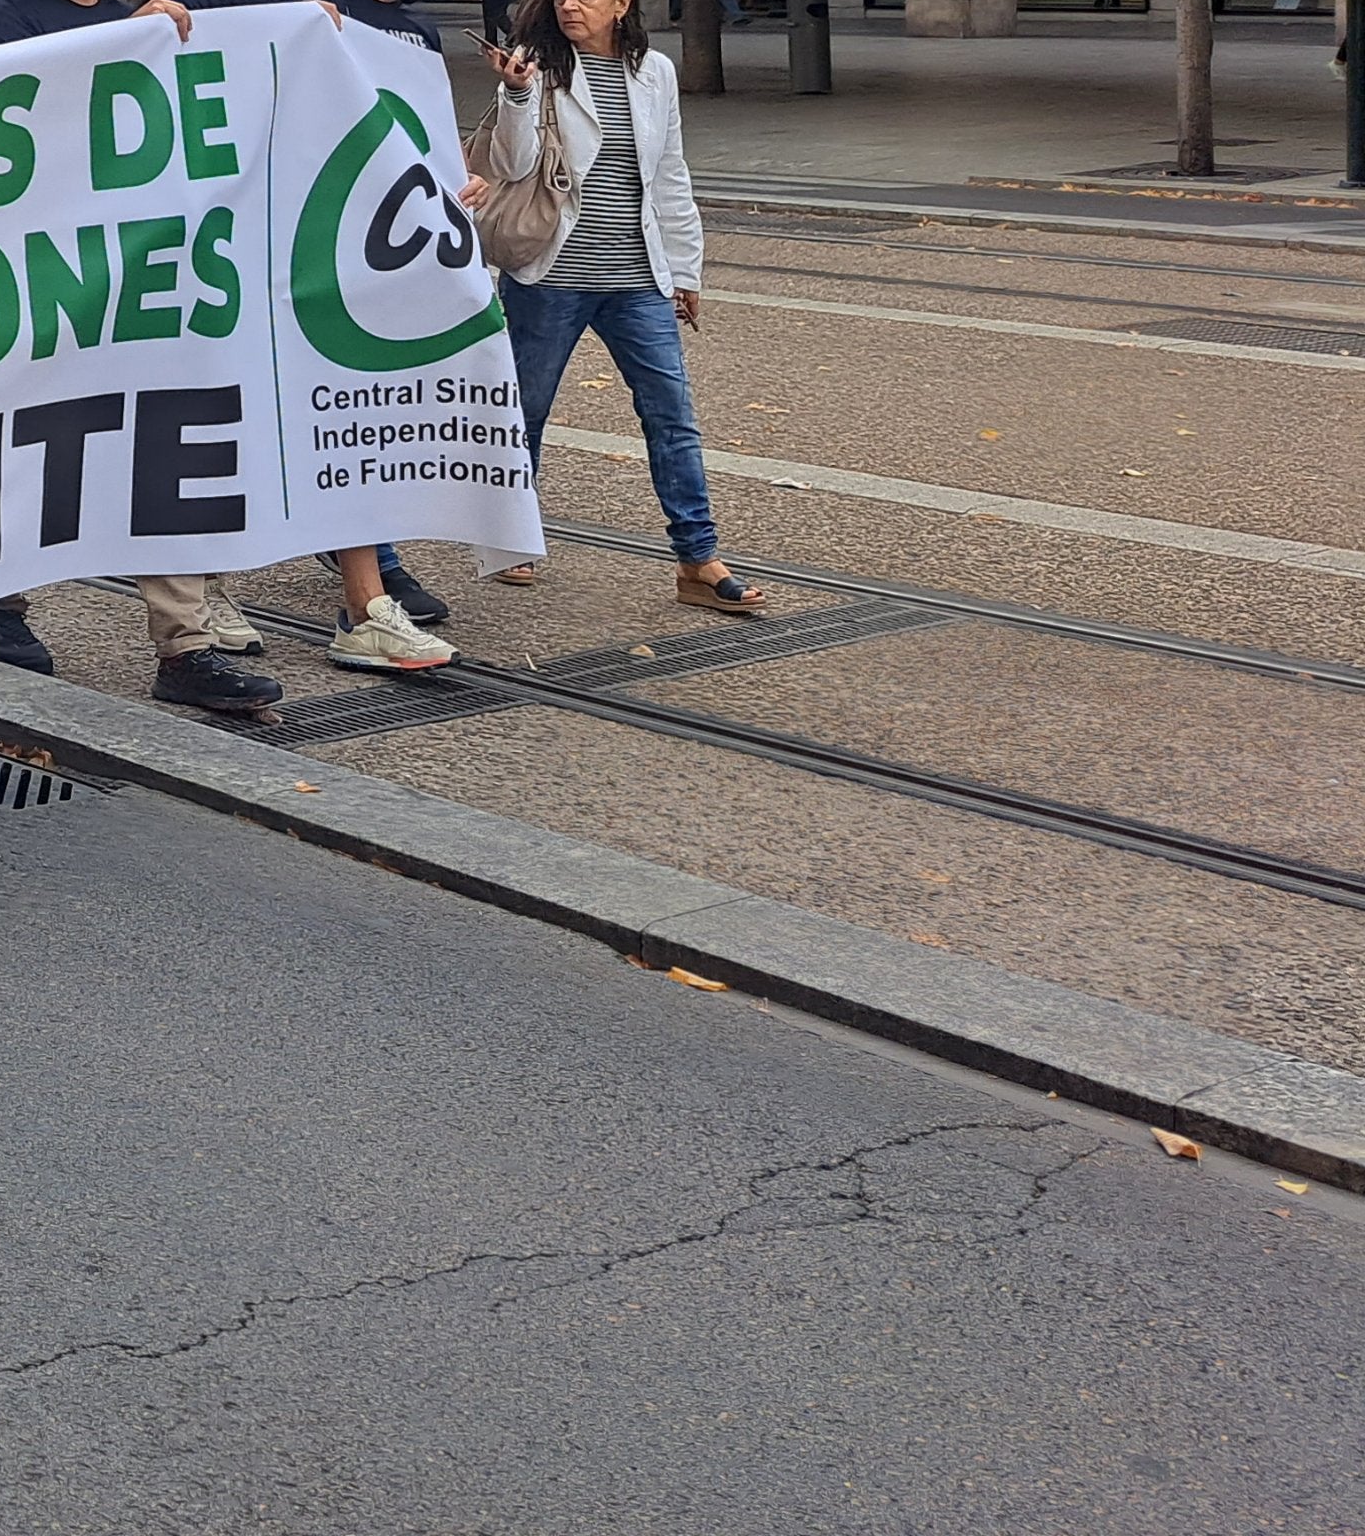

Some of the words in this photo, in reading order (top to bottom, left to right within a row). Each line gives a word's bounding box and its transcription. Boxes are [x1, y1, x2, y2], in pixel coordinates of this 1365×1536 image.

[89, 50, 240, 192] DE
[311, 379, 423, 412] Central
[316, 464, 350, 491] de
